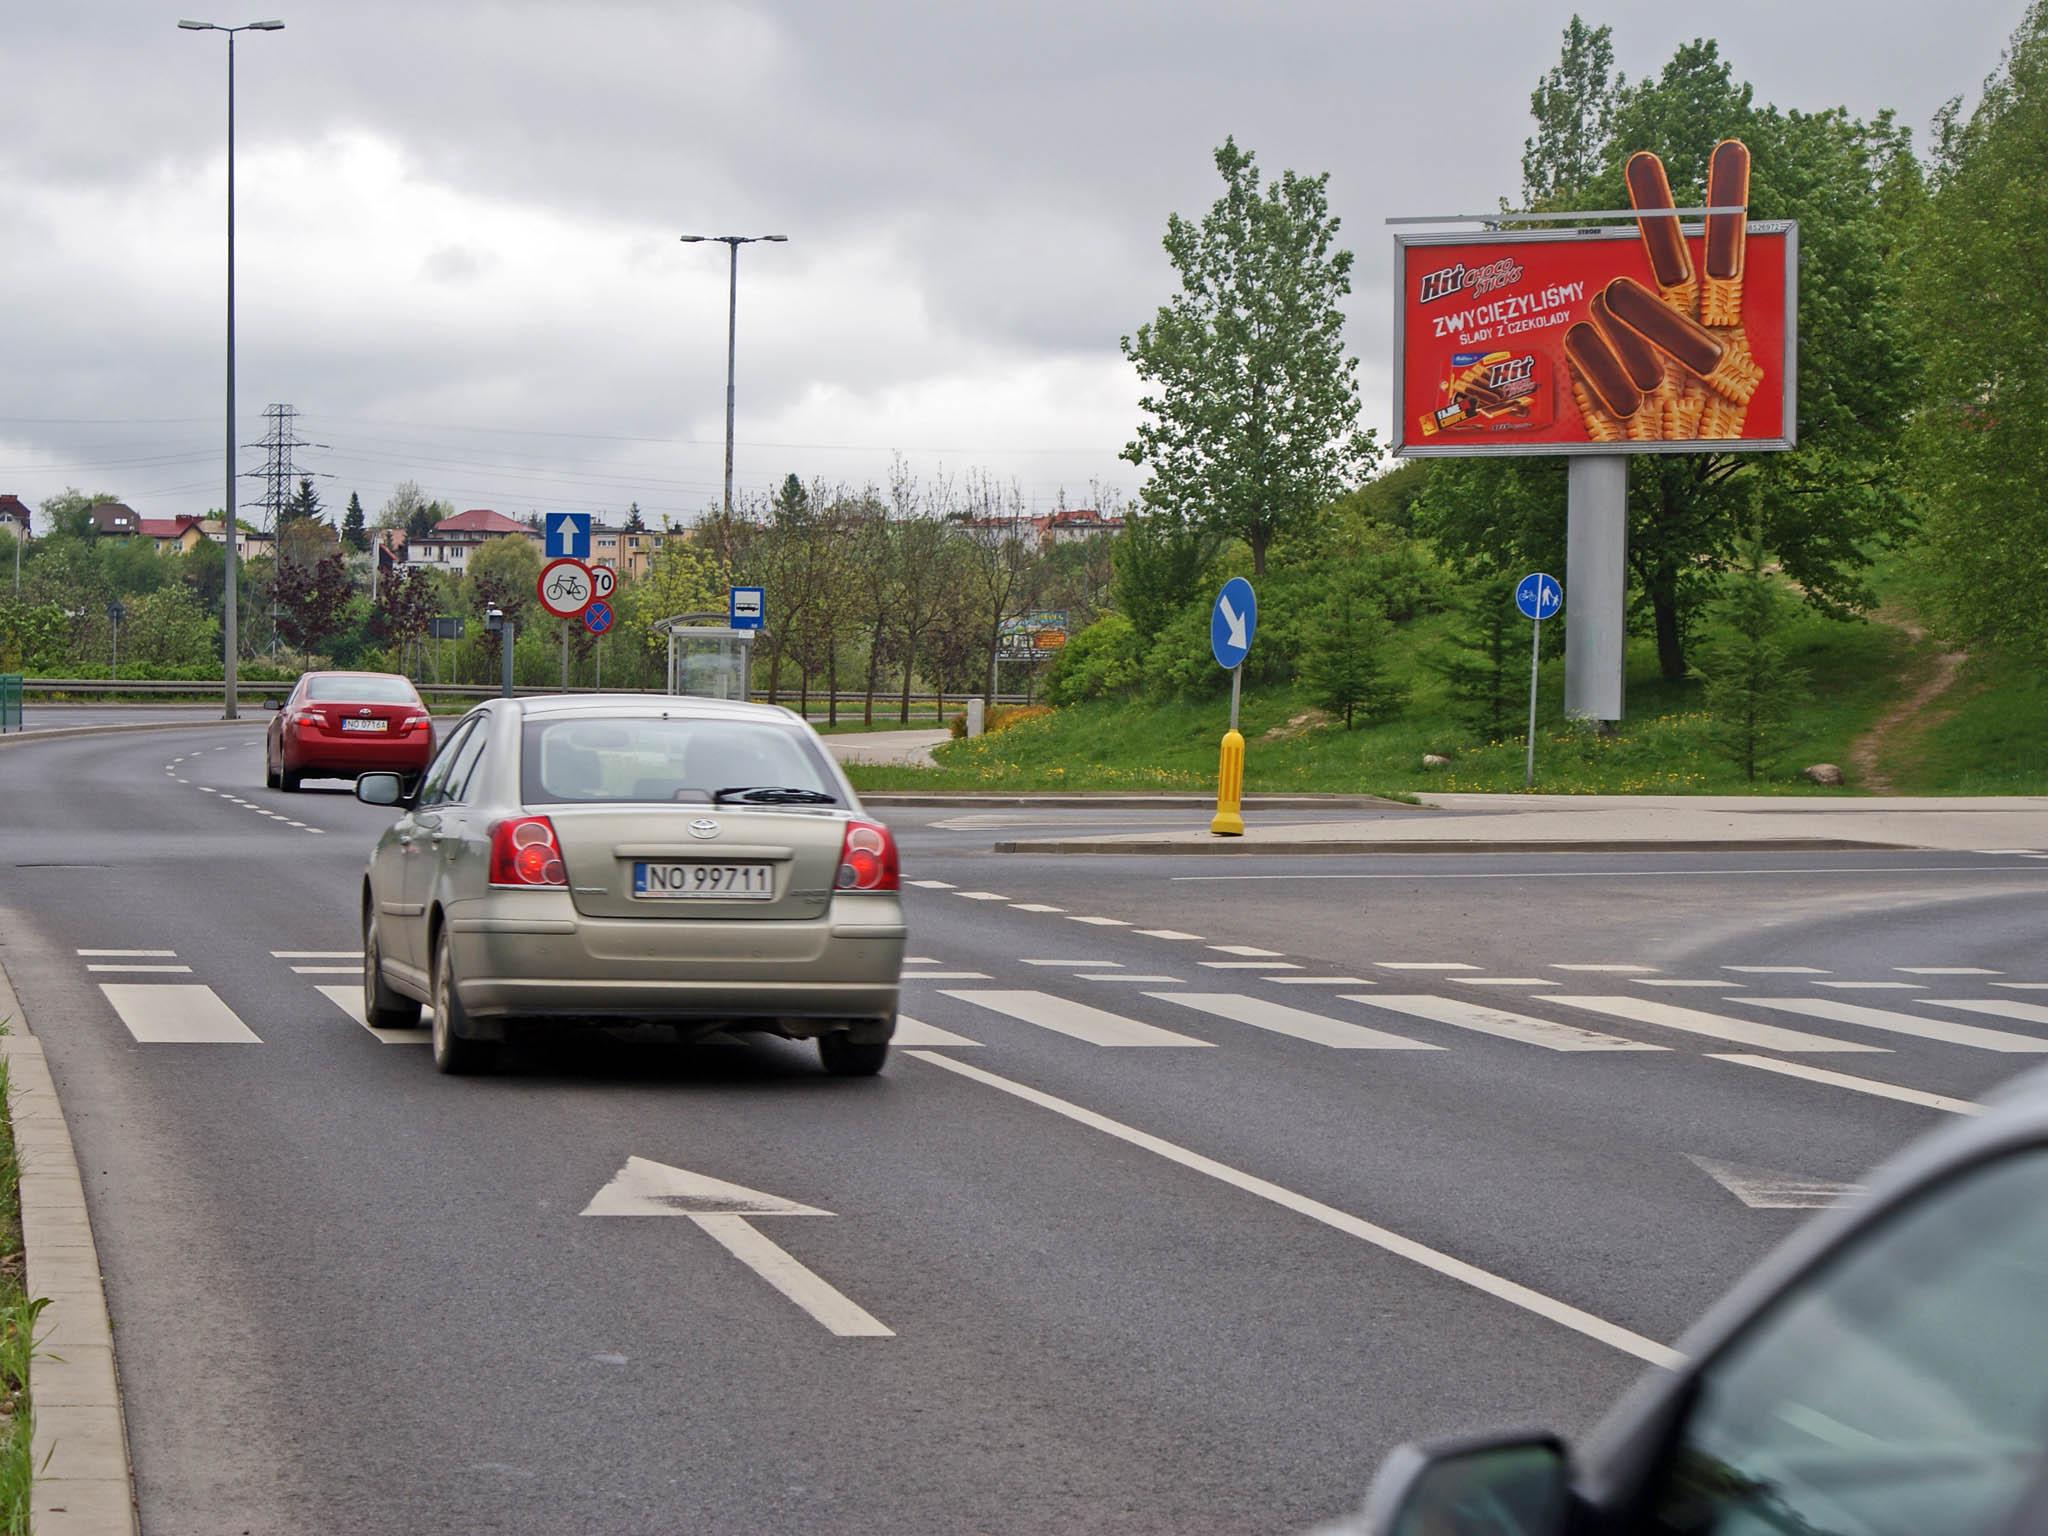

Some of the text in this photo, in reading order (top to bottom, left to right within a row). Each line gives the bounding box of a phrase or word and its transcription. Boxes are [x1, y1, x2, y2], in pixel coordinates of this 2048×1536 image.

[1420, 257, 1514, 304] Hit CHOCO
[1472, 265, 1524, 299] STICKS
[1432, 281, 1585, 338] ZWYCIĘŻYLIŚMY
[1458, 311, 1571, 345] ŚLADY Z CZEKOLADY
[1489, 355, 1535, 389] Hit
[593, 574, 612, 590] 70
[347, 719, 359, 729] NO
[651, 866, 766, 891] NO 99711
